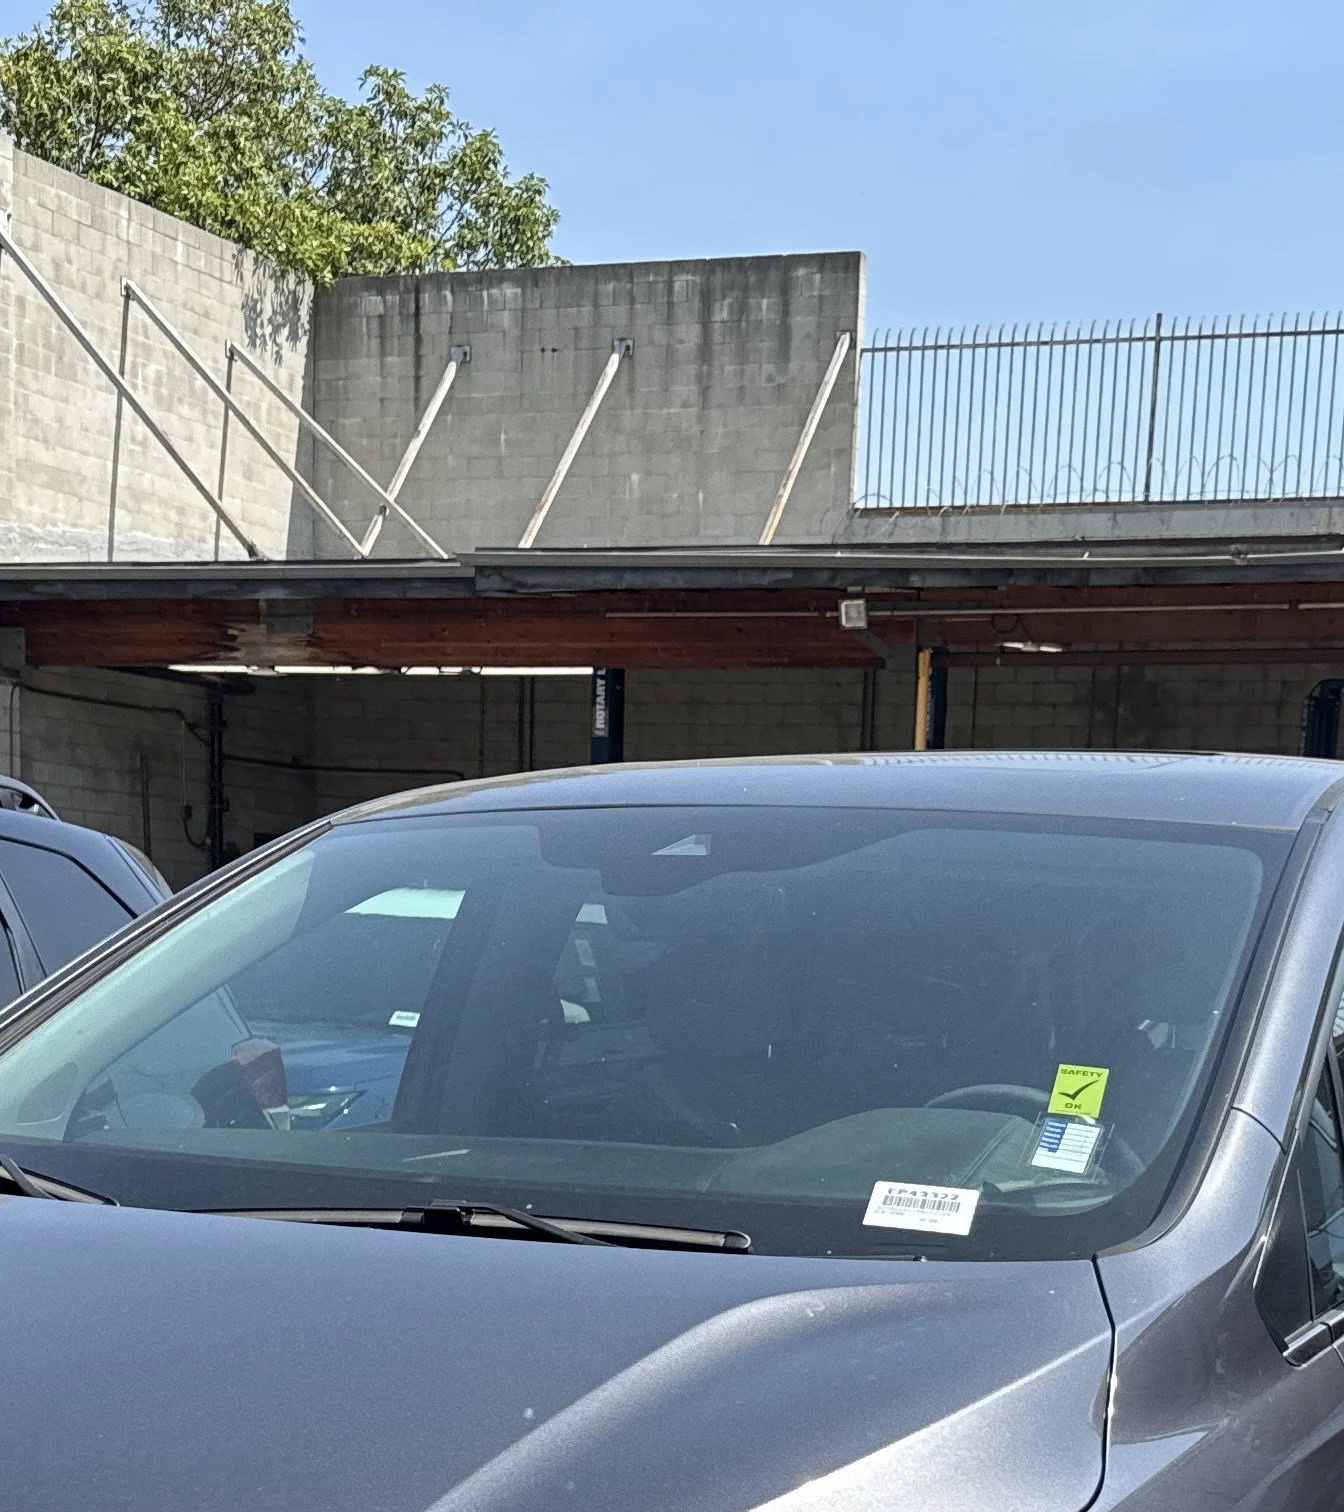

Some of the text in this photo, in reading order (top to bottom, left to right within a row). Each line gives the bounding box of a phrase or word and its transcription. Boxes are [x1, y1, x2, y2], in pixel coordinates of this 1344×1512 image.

[596, 678, 606, 729] ROTARY
[1060, 1068, 1104, 1078] SAFETY
[1064, 1102, 1082, 1110] OK
